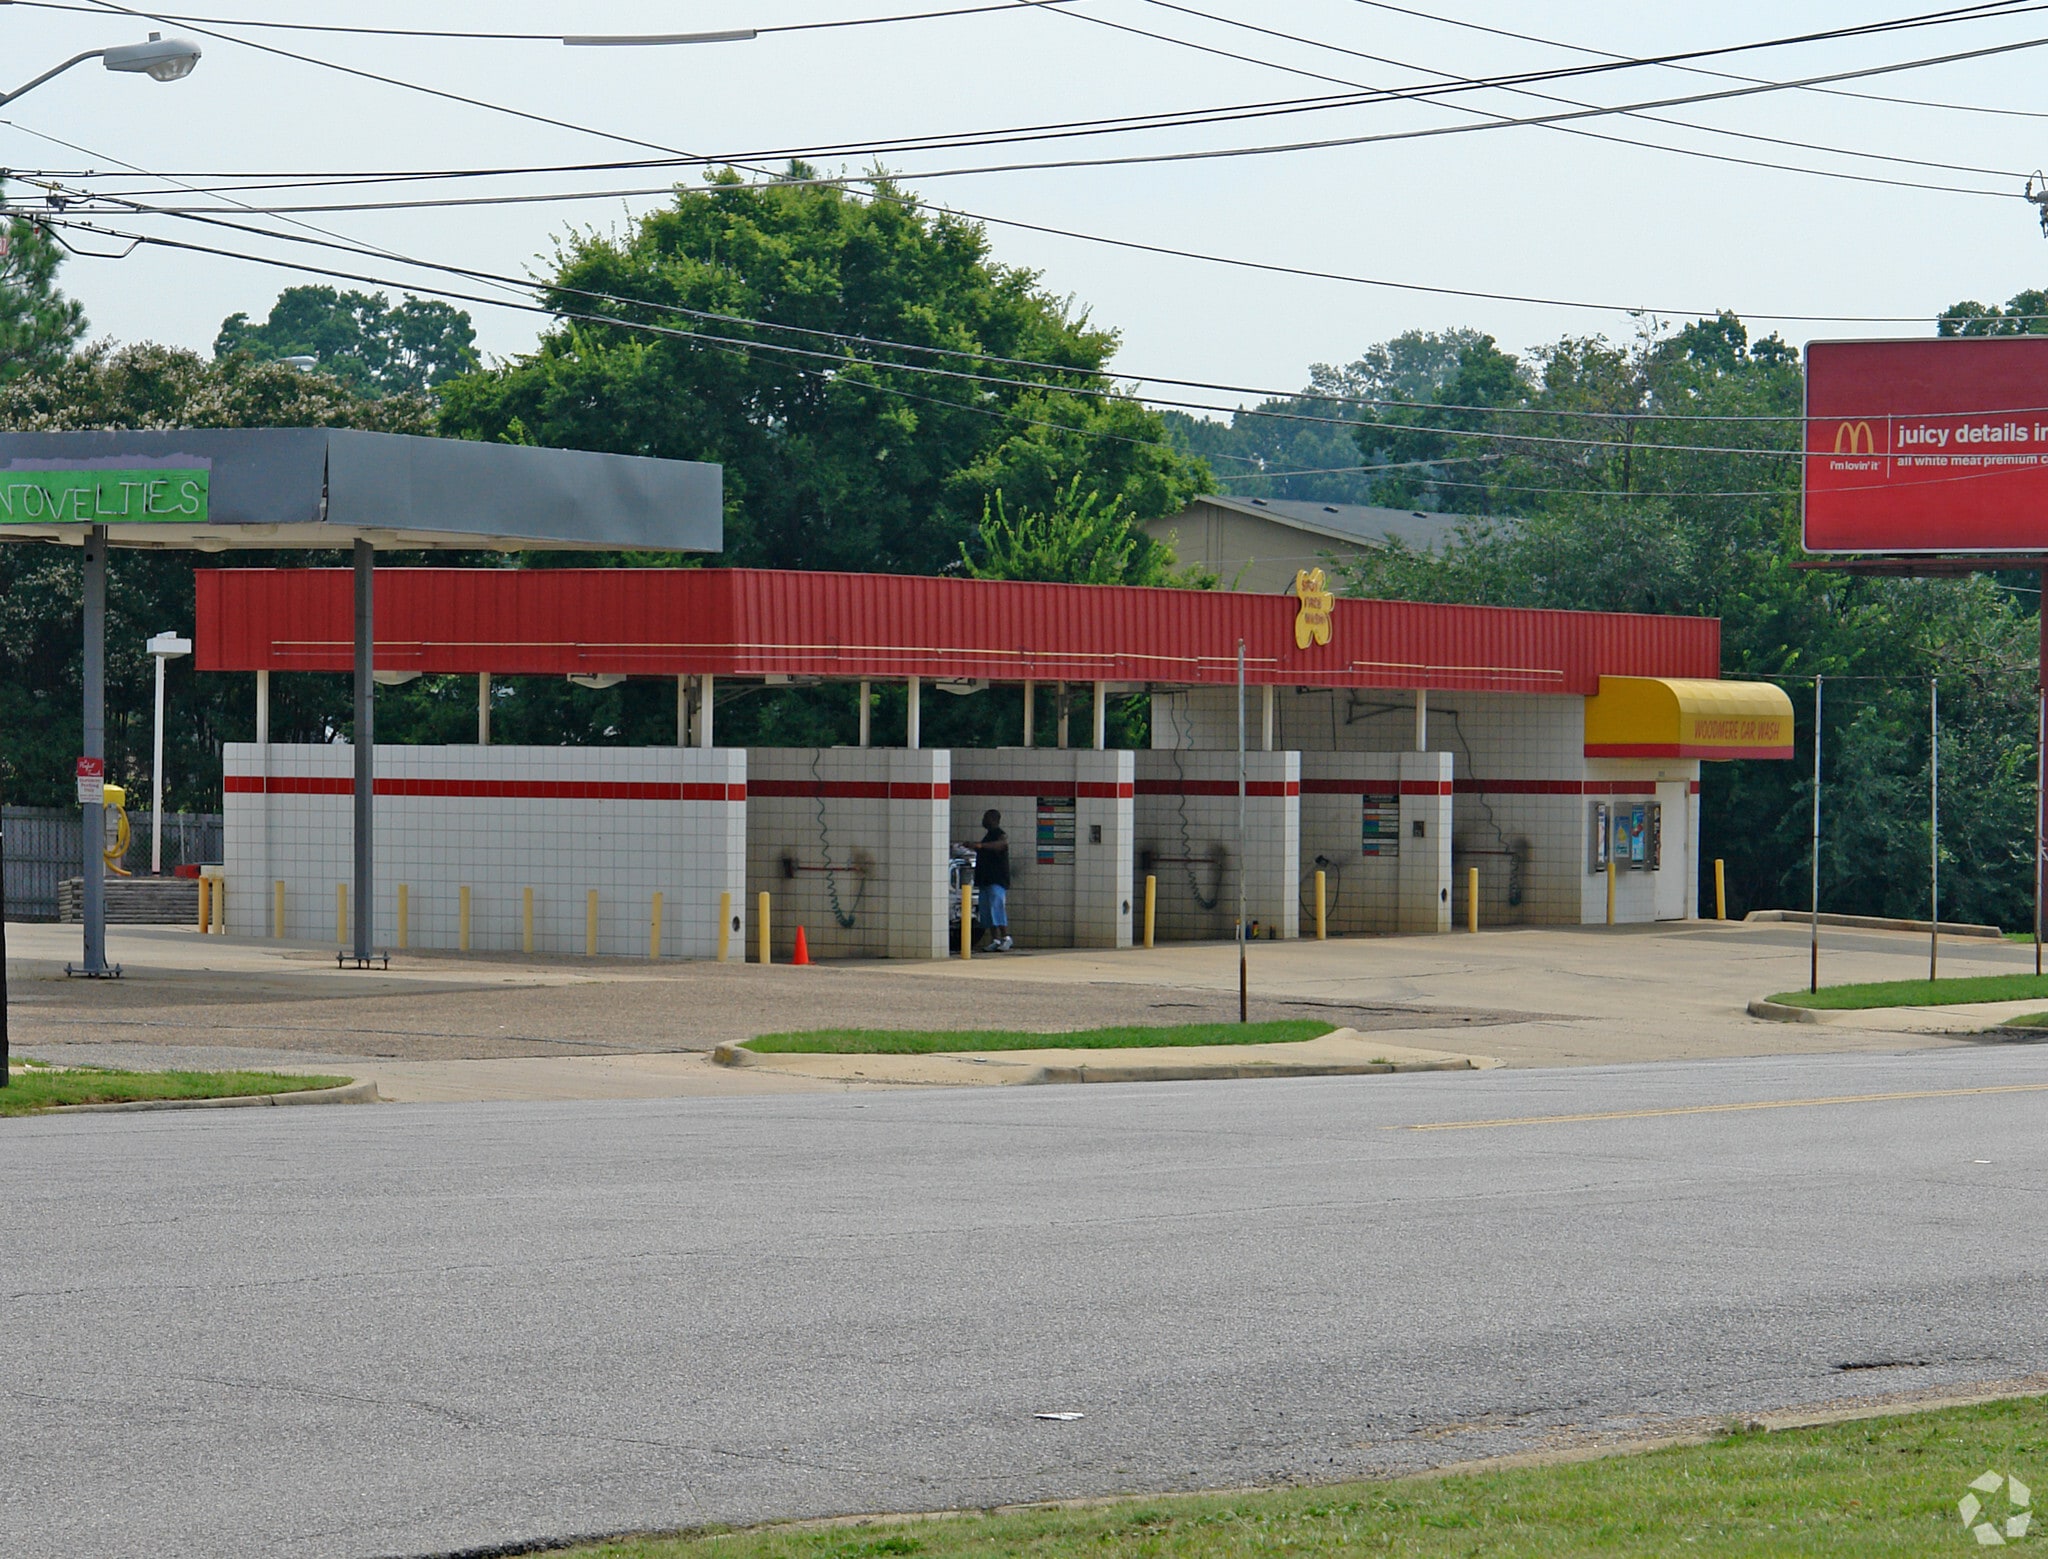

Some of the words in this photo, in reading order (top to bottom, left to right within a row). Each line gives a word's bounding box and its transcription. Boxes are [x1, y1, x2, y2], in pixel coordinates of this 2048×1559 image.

[1897, 424, 1950, 448] juicy
[1955, 422, 2029, 443] details
[1830, 460, 1844, 470] I'm
[1845, 460, 1870, 470] lovin'
[1871, 460, 1878, 470] it
[1897, 456, 1912, 466] all
[1915, 456, 1949, 466] white
[1951, 456, 1982, 466] meat
[1983, 455, 2038, 468] premium
[0, 480, 200, 522] NOVELTIES
[1694, 719, 1739, 740] WOODMERE
[1741, 721, 1755, 741] CAR
[1757, 720, 1780, 742] WASH
